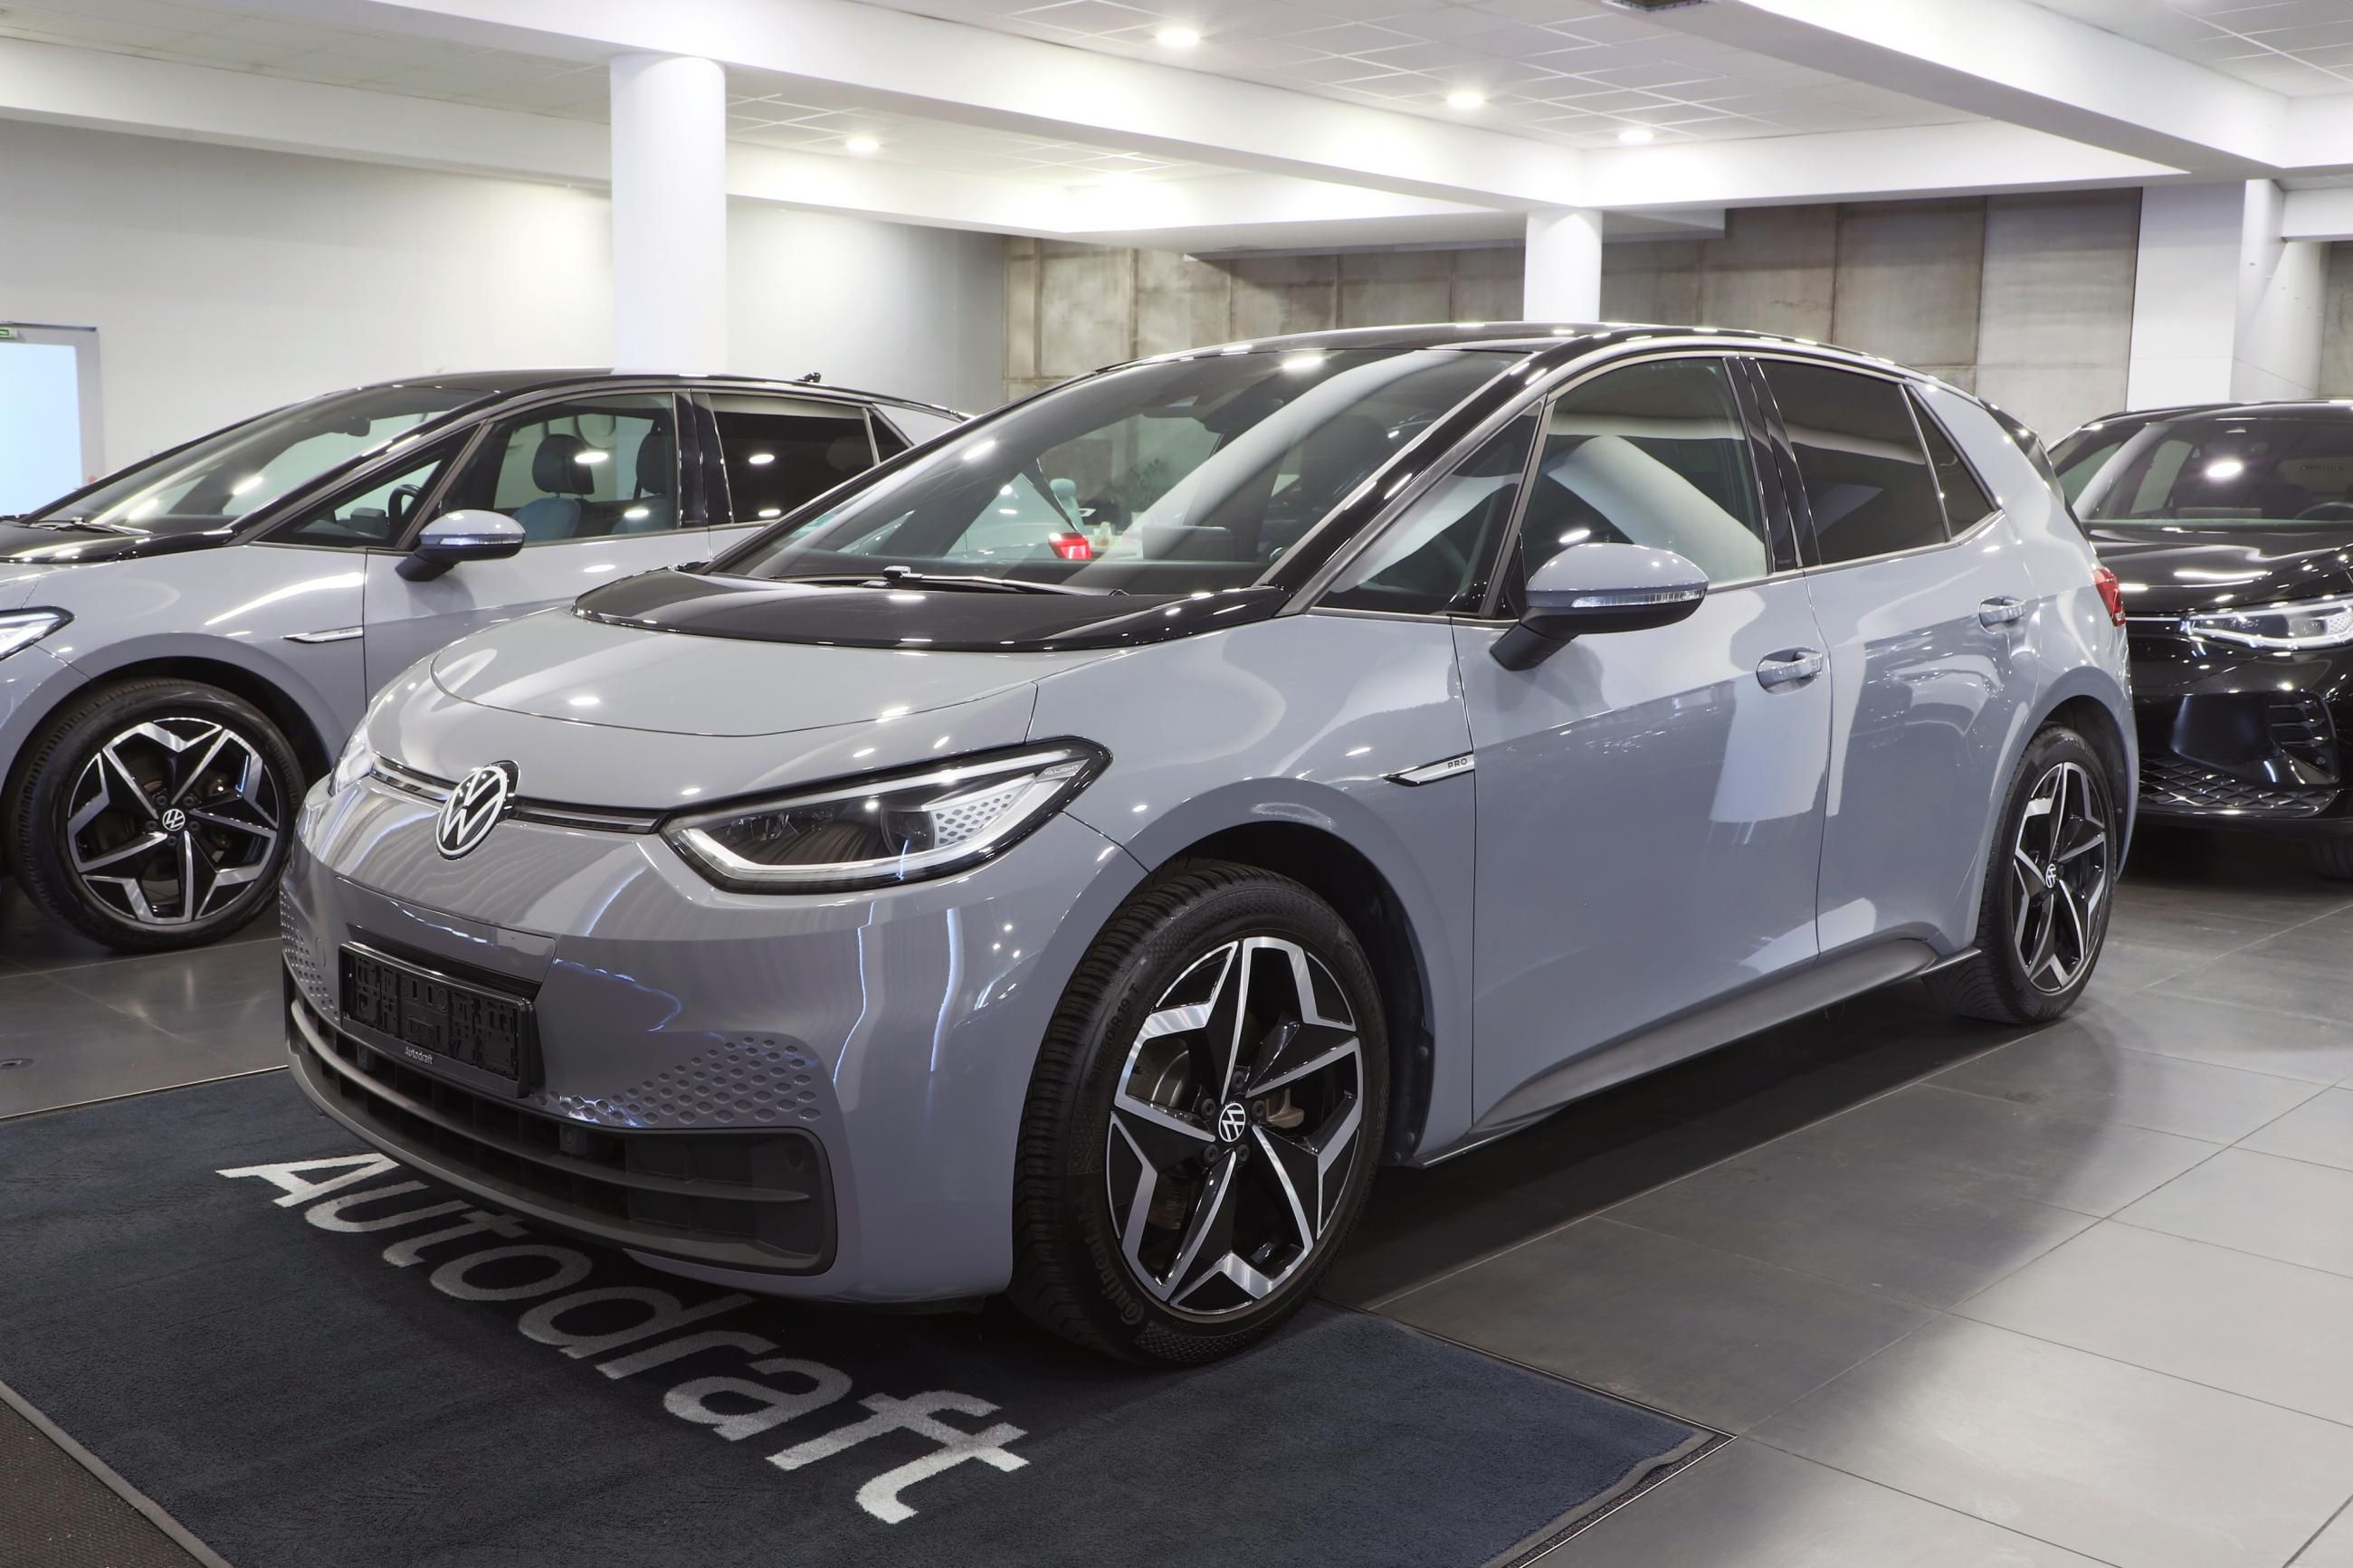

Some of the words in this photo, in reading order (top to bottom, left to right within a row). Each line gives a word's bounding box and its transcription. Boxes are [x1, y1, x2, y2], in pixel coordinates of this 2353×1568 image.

[1448, 757, 1468, 769] PRO
[436, 765, 508, 856] VW
[405, 1046, 433, 1065] Autodraft
[215, 1153, 1030, 1525] Autodraft
